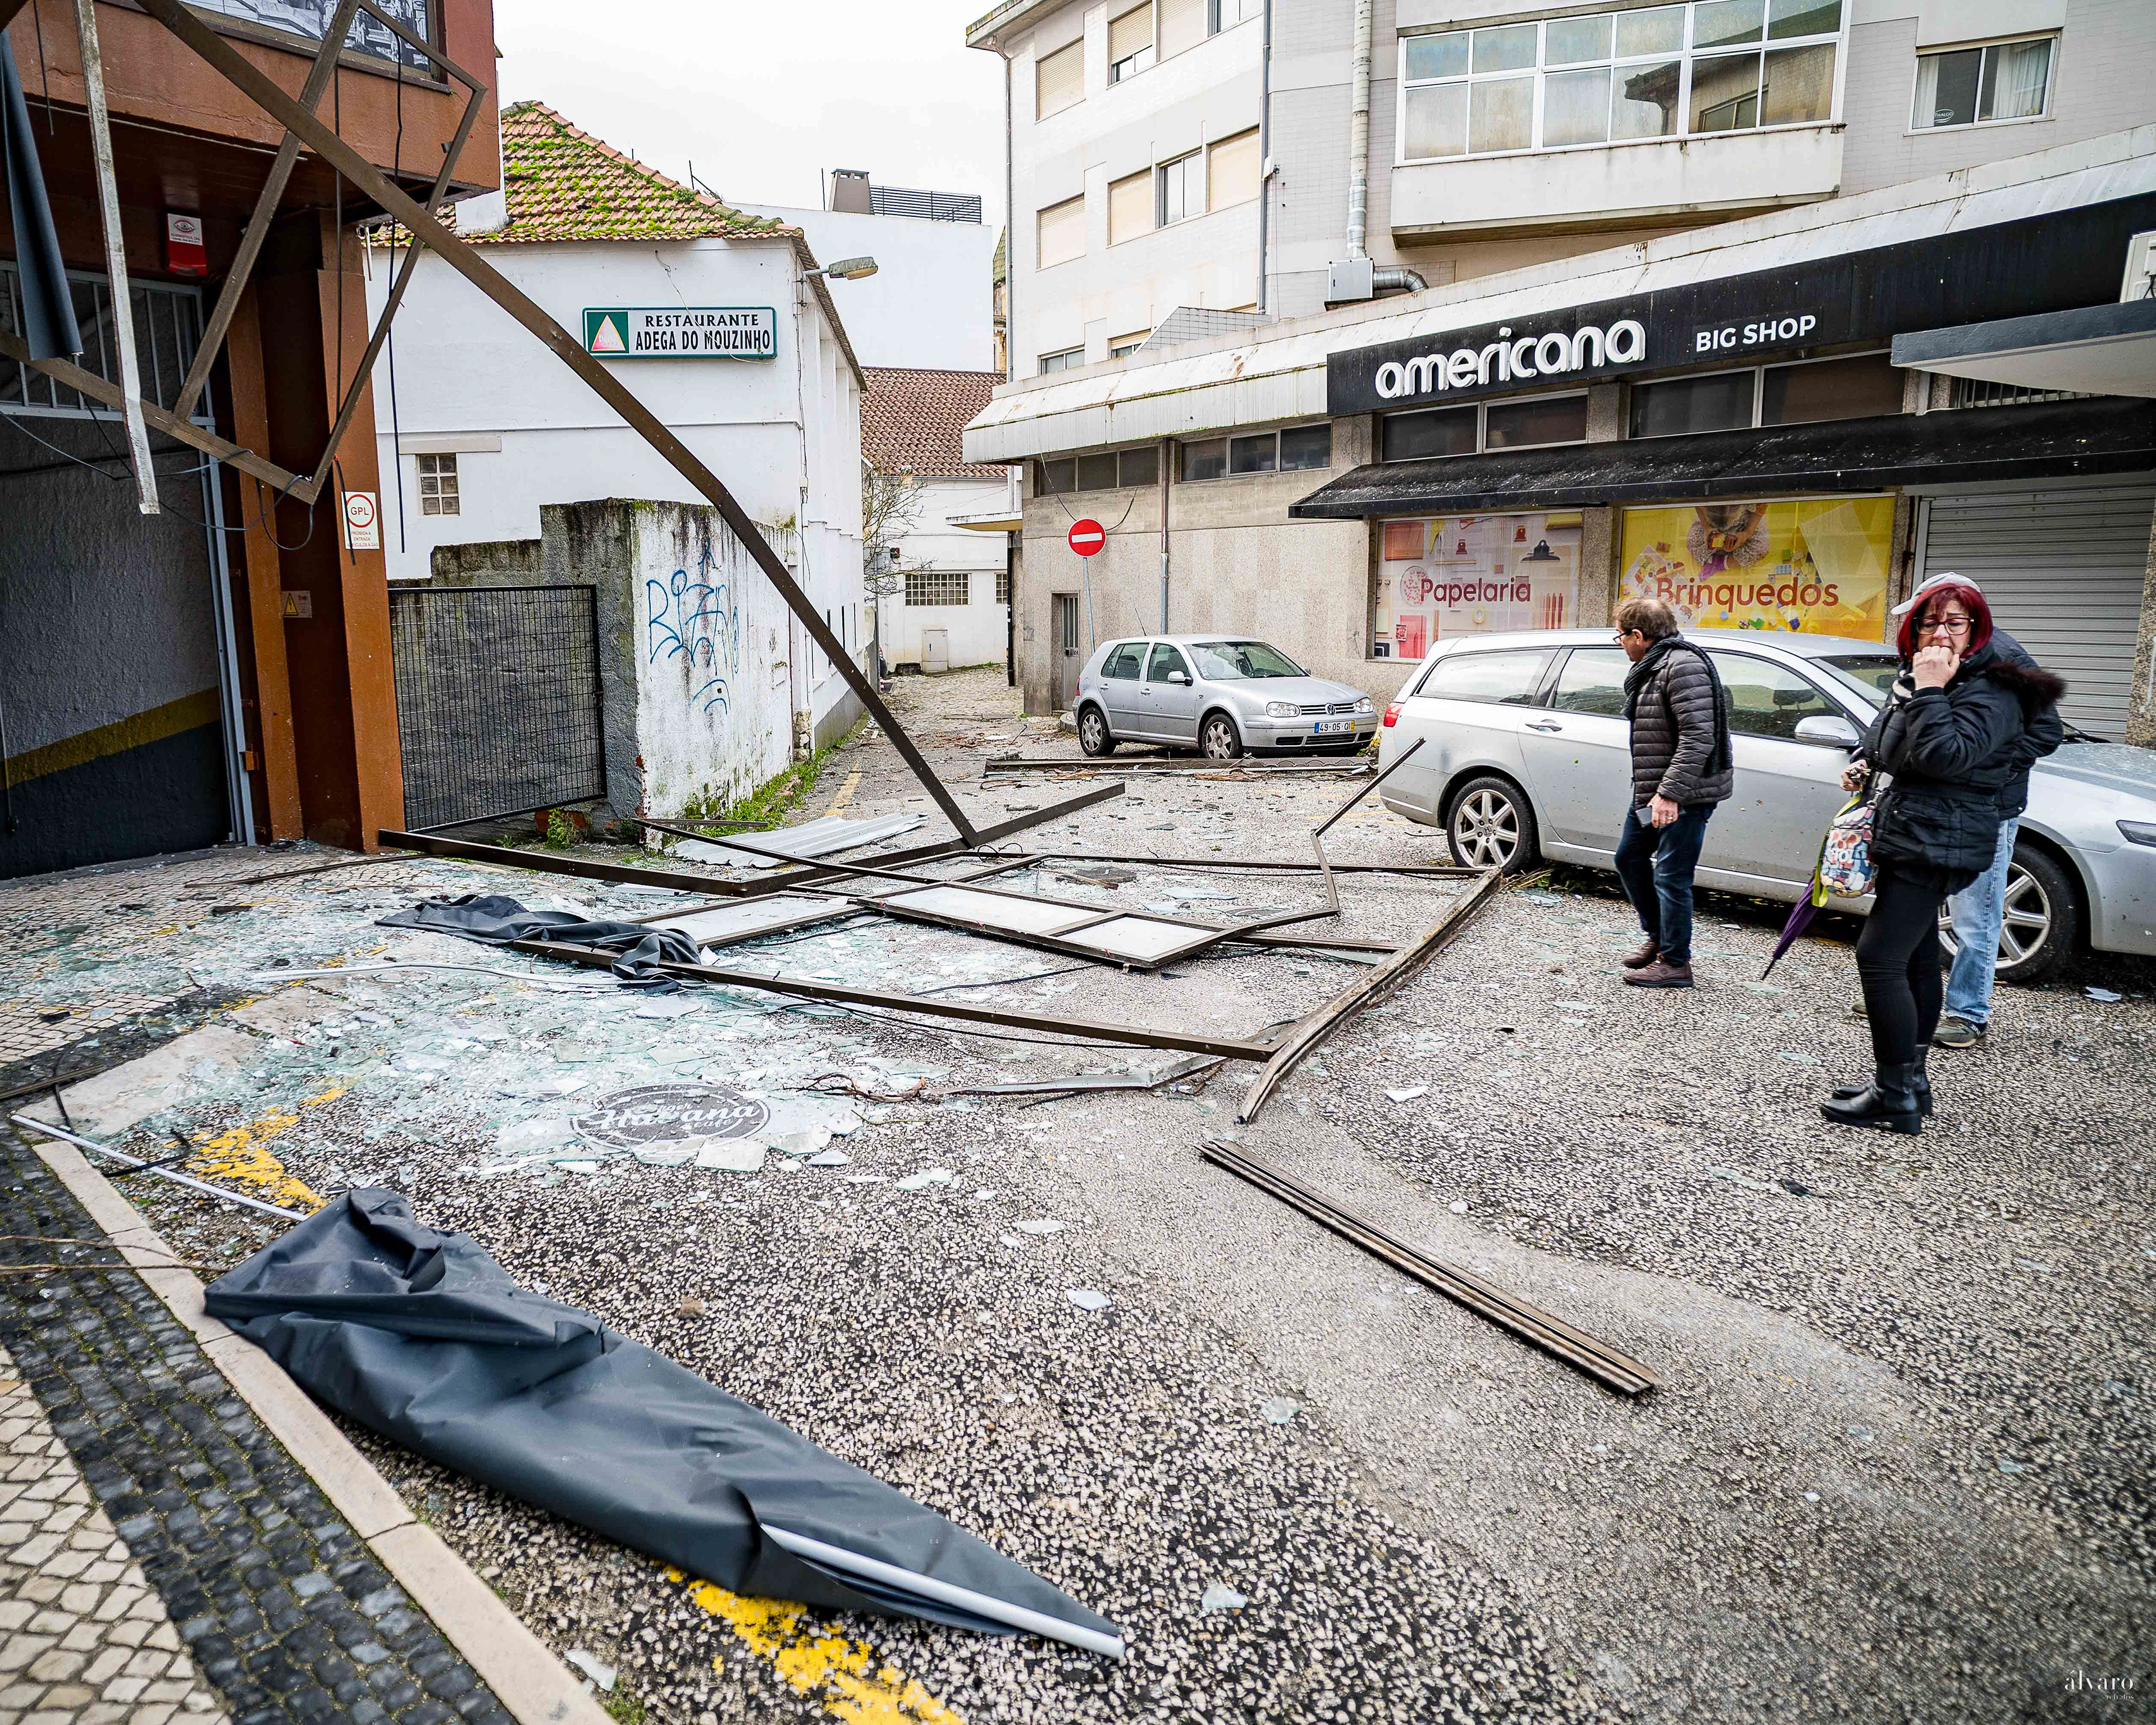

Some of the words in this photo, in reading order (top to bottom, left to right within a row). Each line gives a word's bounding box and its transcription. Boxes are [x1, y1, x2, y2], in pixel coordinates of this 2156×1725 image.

[645, 314, 759, 327] RESTAURANTE
[1696, 327, 1736, 352] BIG
[1742, 315, 1816, 344] SHOP
[636, 330, 677, 350] ADEGA
[682, 330, 698, 350] DO
[704, 329, 770, 350] MOUZINHO
[1375, 320, 1646, 399] americana
[1420, 577, 1531, 608] Papelaria
[1657, 577, 1839, 613] Brinquedos
